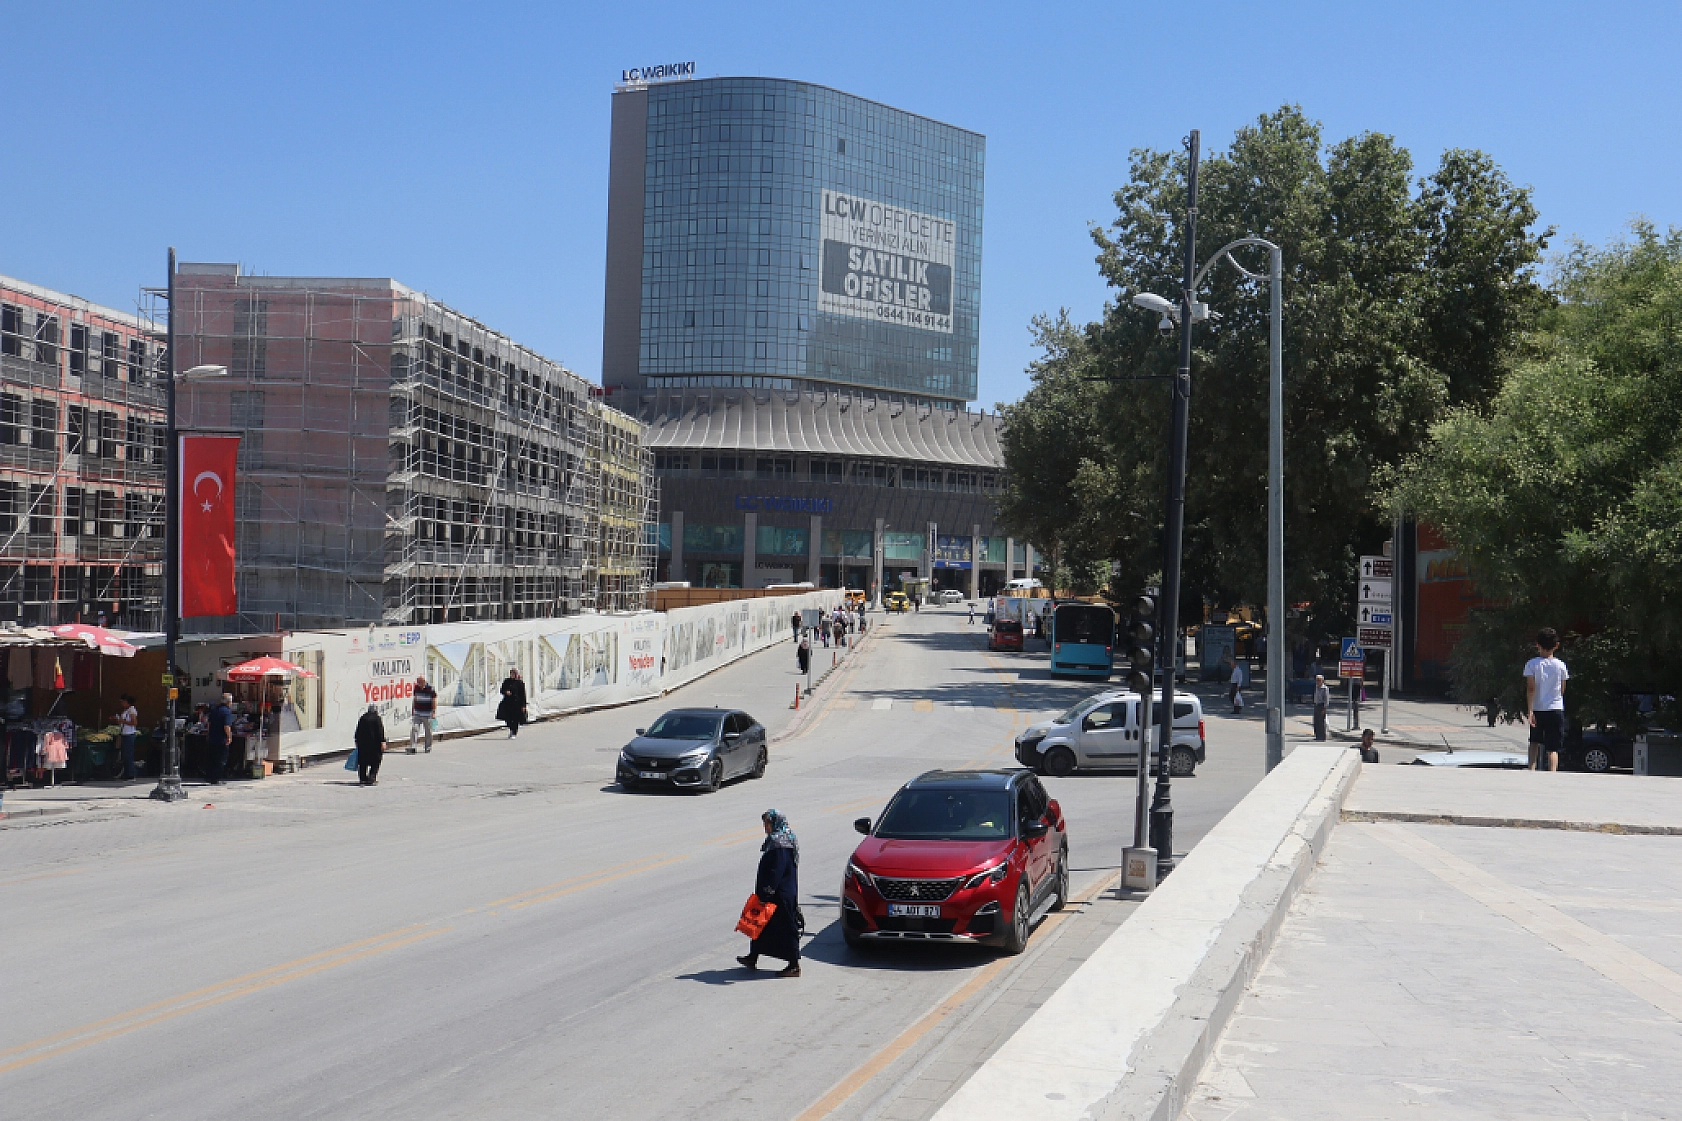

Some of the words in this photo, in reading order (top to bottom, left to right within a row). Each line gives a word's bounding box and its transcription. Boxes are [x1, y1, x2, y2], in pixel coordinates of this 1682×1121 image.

[622, 68, 640, 81] LC
[825, 193, 867, 222] LCW
[847, 246, 930, 286] SATILIK
[735, 494, 760, 511] LC
[372, 659, 411, 677] MALATYA
